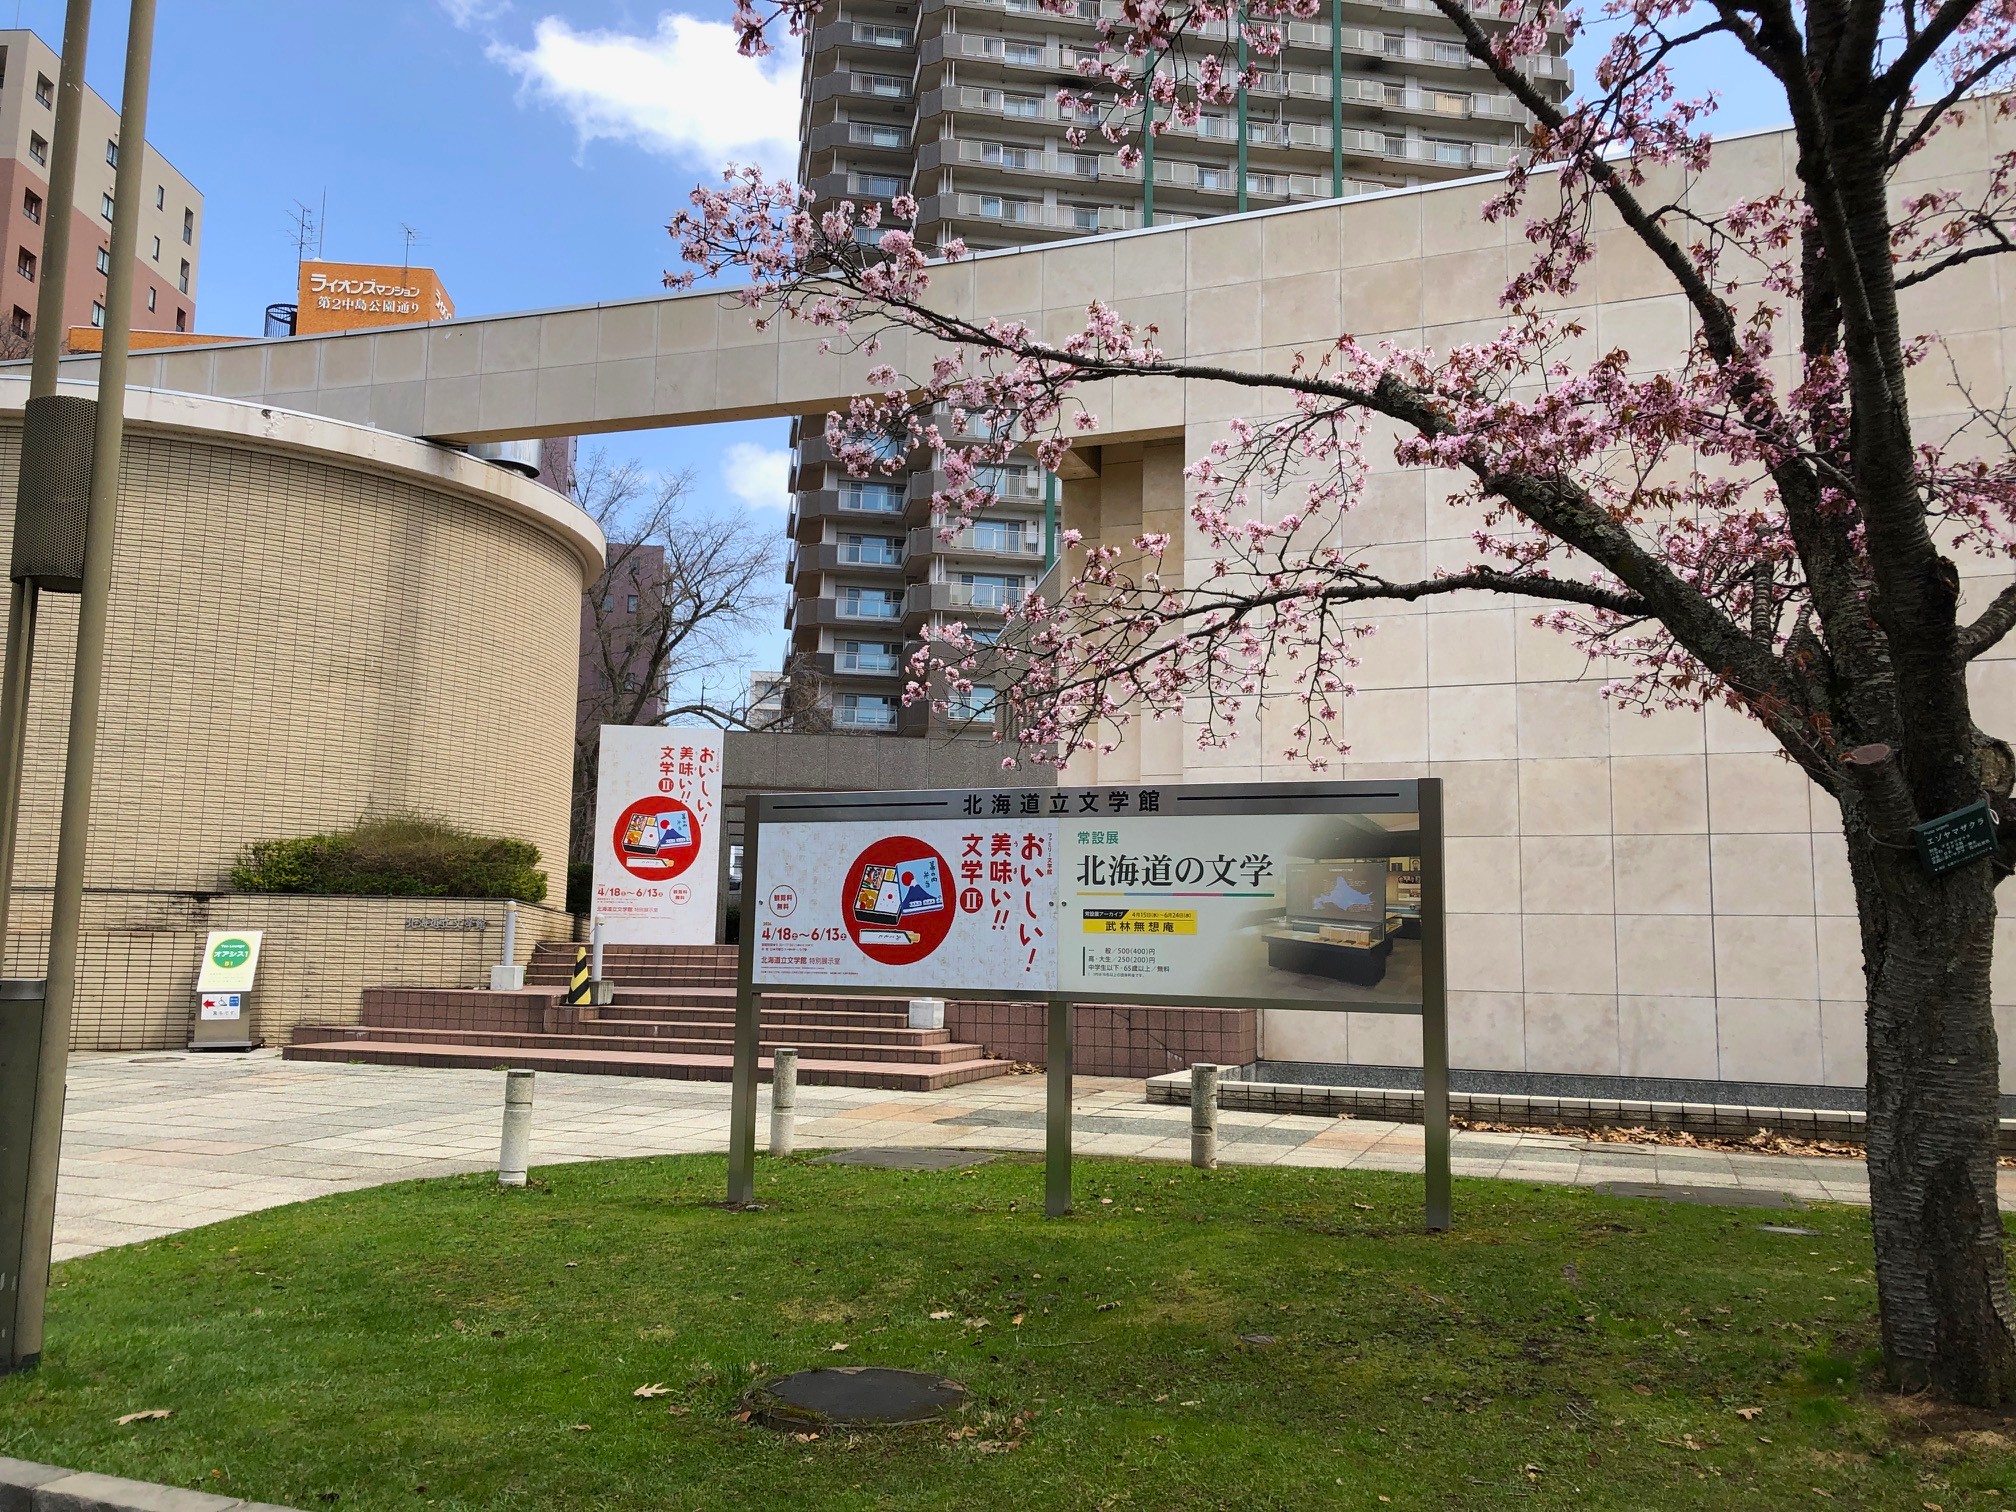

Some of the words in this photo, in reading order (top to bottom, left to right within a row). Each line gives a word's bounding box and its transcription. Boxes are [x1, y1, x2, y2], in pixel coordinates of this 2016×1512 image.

[310, 273, 420, 298] ライオンズマンション
[317, 295, 419, 314] 第2中島公園通り
[963, 790, 1160, 815] 北海道立文学館
[1077, 831, 1119, 845] 常設展
[1076, 853, 1274, 888] 北海道の文学
[1105, 921, 1175, 933] 武林無想庵
[761, 956, 807, 965] 北海道立文学館
[809, 957, 841, 965] 特別展示室
